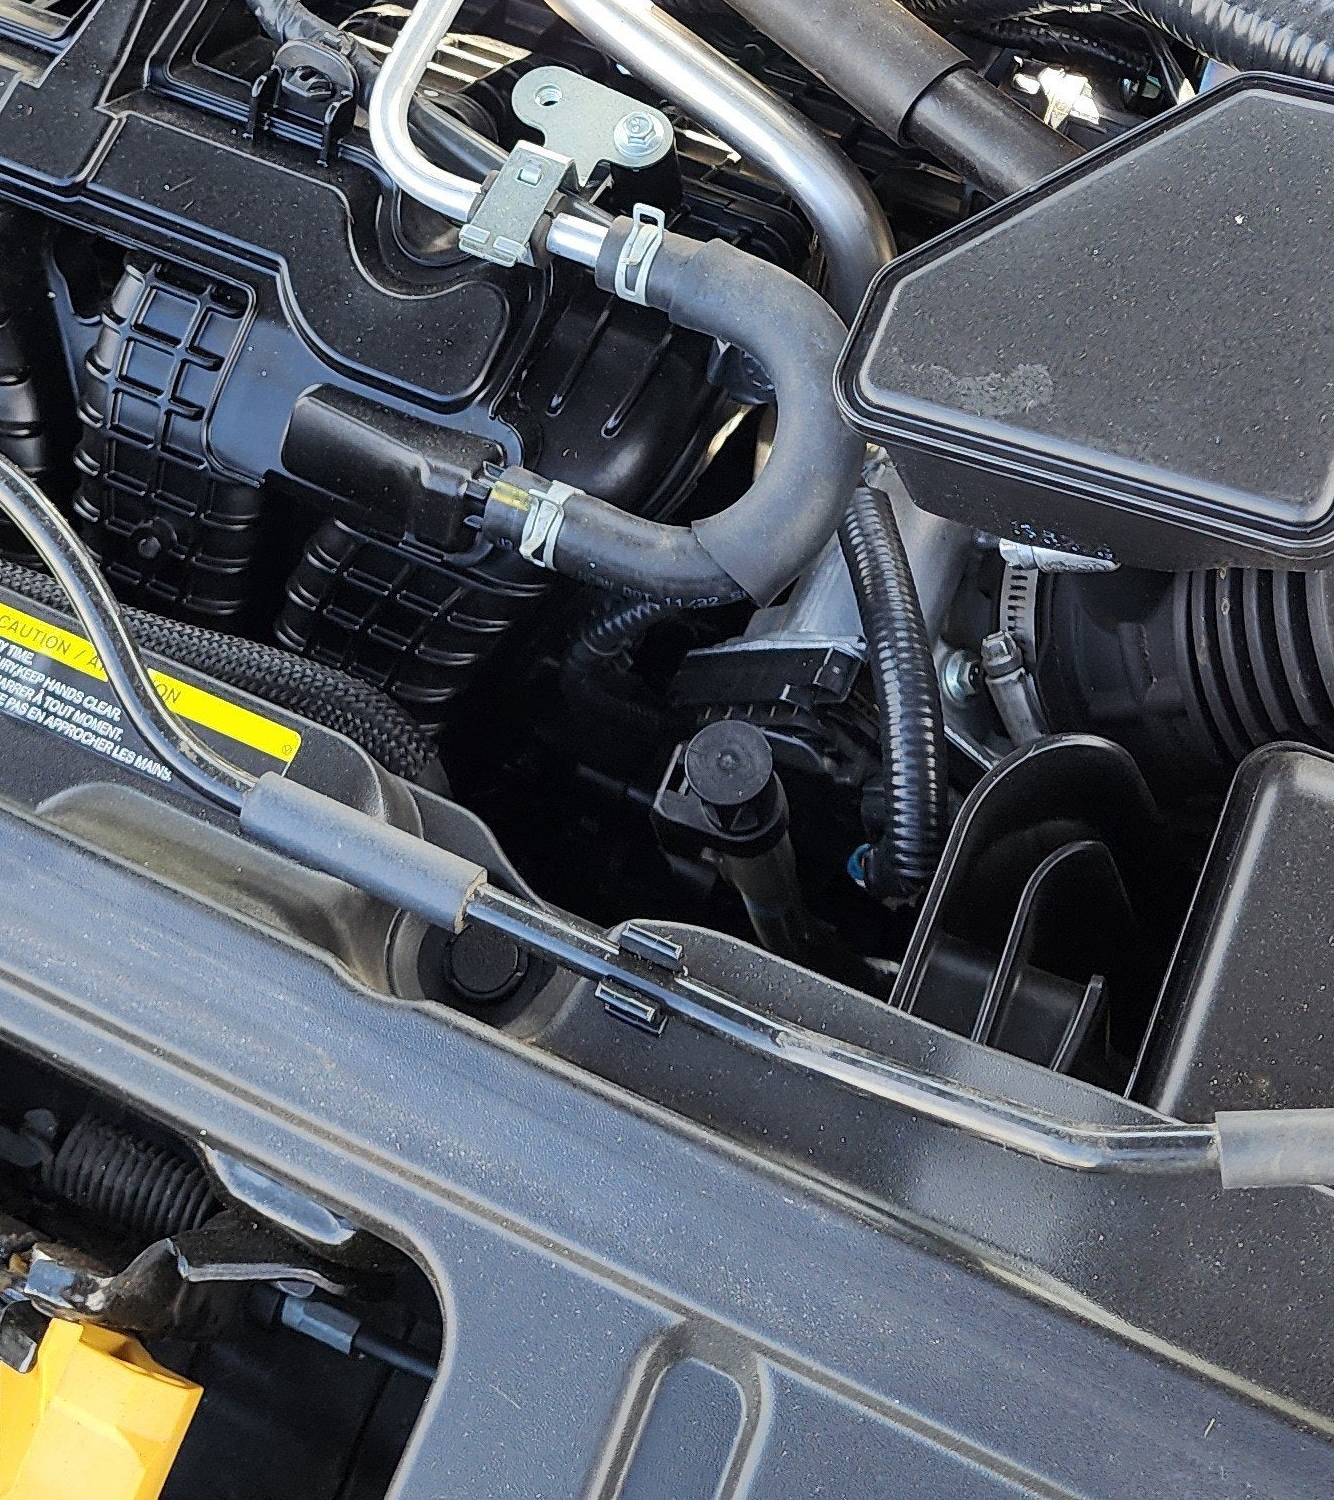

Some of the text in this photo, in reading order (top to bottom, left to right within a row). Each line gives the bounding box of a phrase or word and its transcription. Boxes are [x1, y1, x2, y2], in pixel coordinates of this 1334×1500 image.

[30, 687, 46, 706] À
[41, 694, 76, 720] TOUT
[40, 675, 85, 705] HANDS
[2, 696, 29, 719] PAS
[25, 705, 47, 725] EN
[41, 712, 117, 757] APPROCHER
[110, 743, 139, 766] LES
